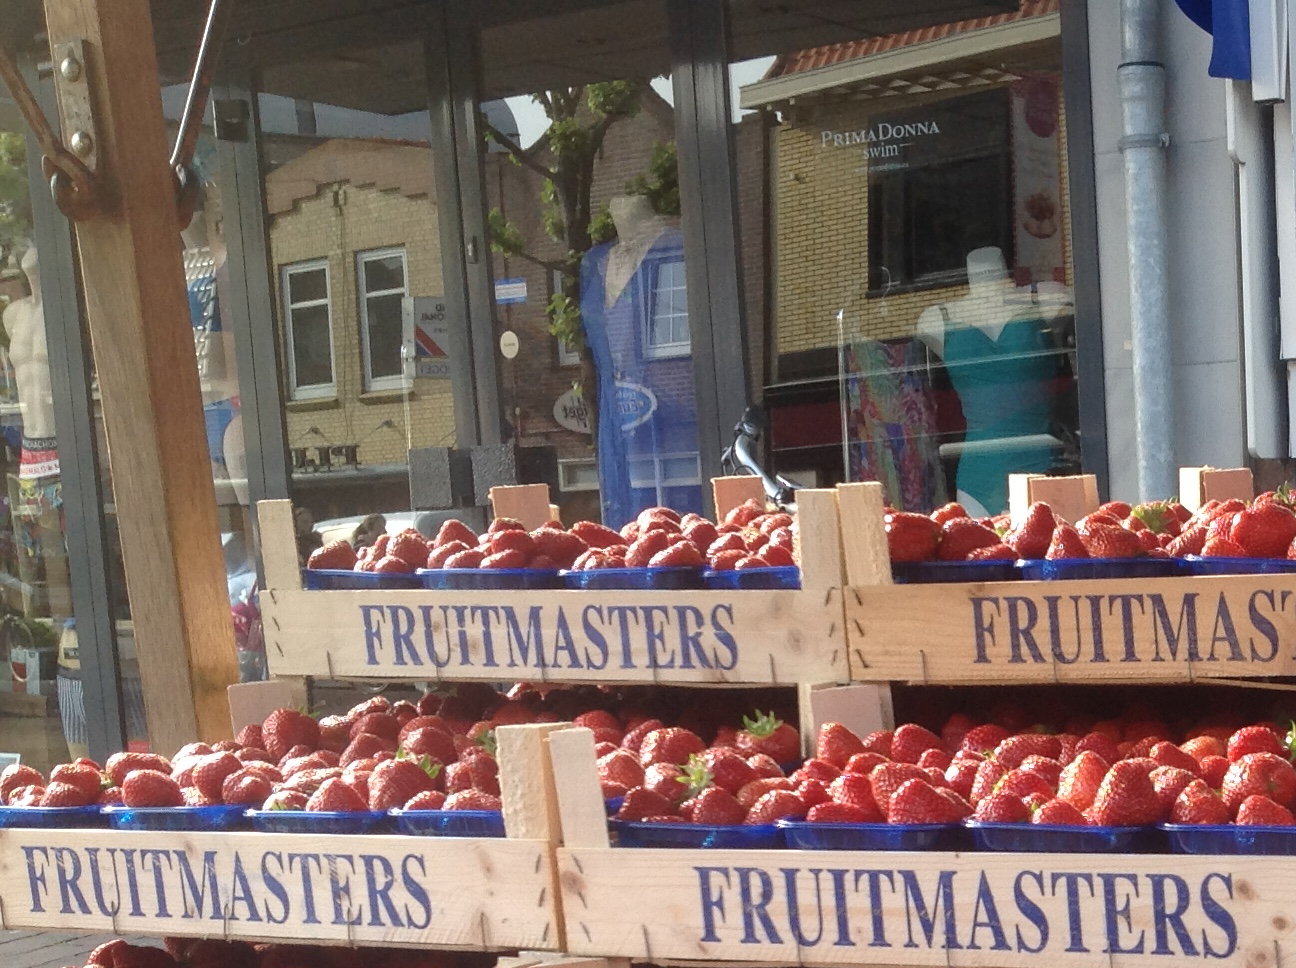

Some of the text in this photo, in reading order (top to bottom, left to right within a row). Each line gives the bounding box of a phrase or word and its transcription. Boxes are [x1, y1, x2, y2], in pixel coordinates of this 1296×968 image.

[863, 142, 899, 160] swim
[359, 603, 739, 671] FRUITMASTERS
[20, 845, 433, 930] FRUITMASTERS
[693, 865, 1240, 960] FRUITMASTERS
